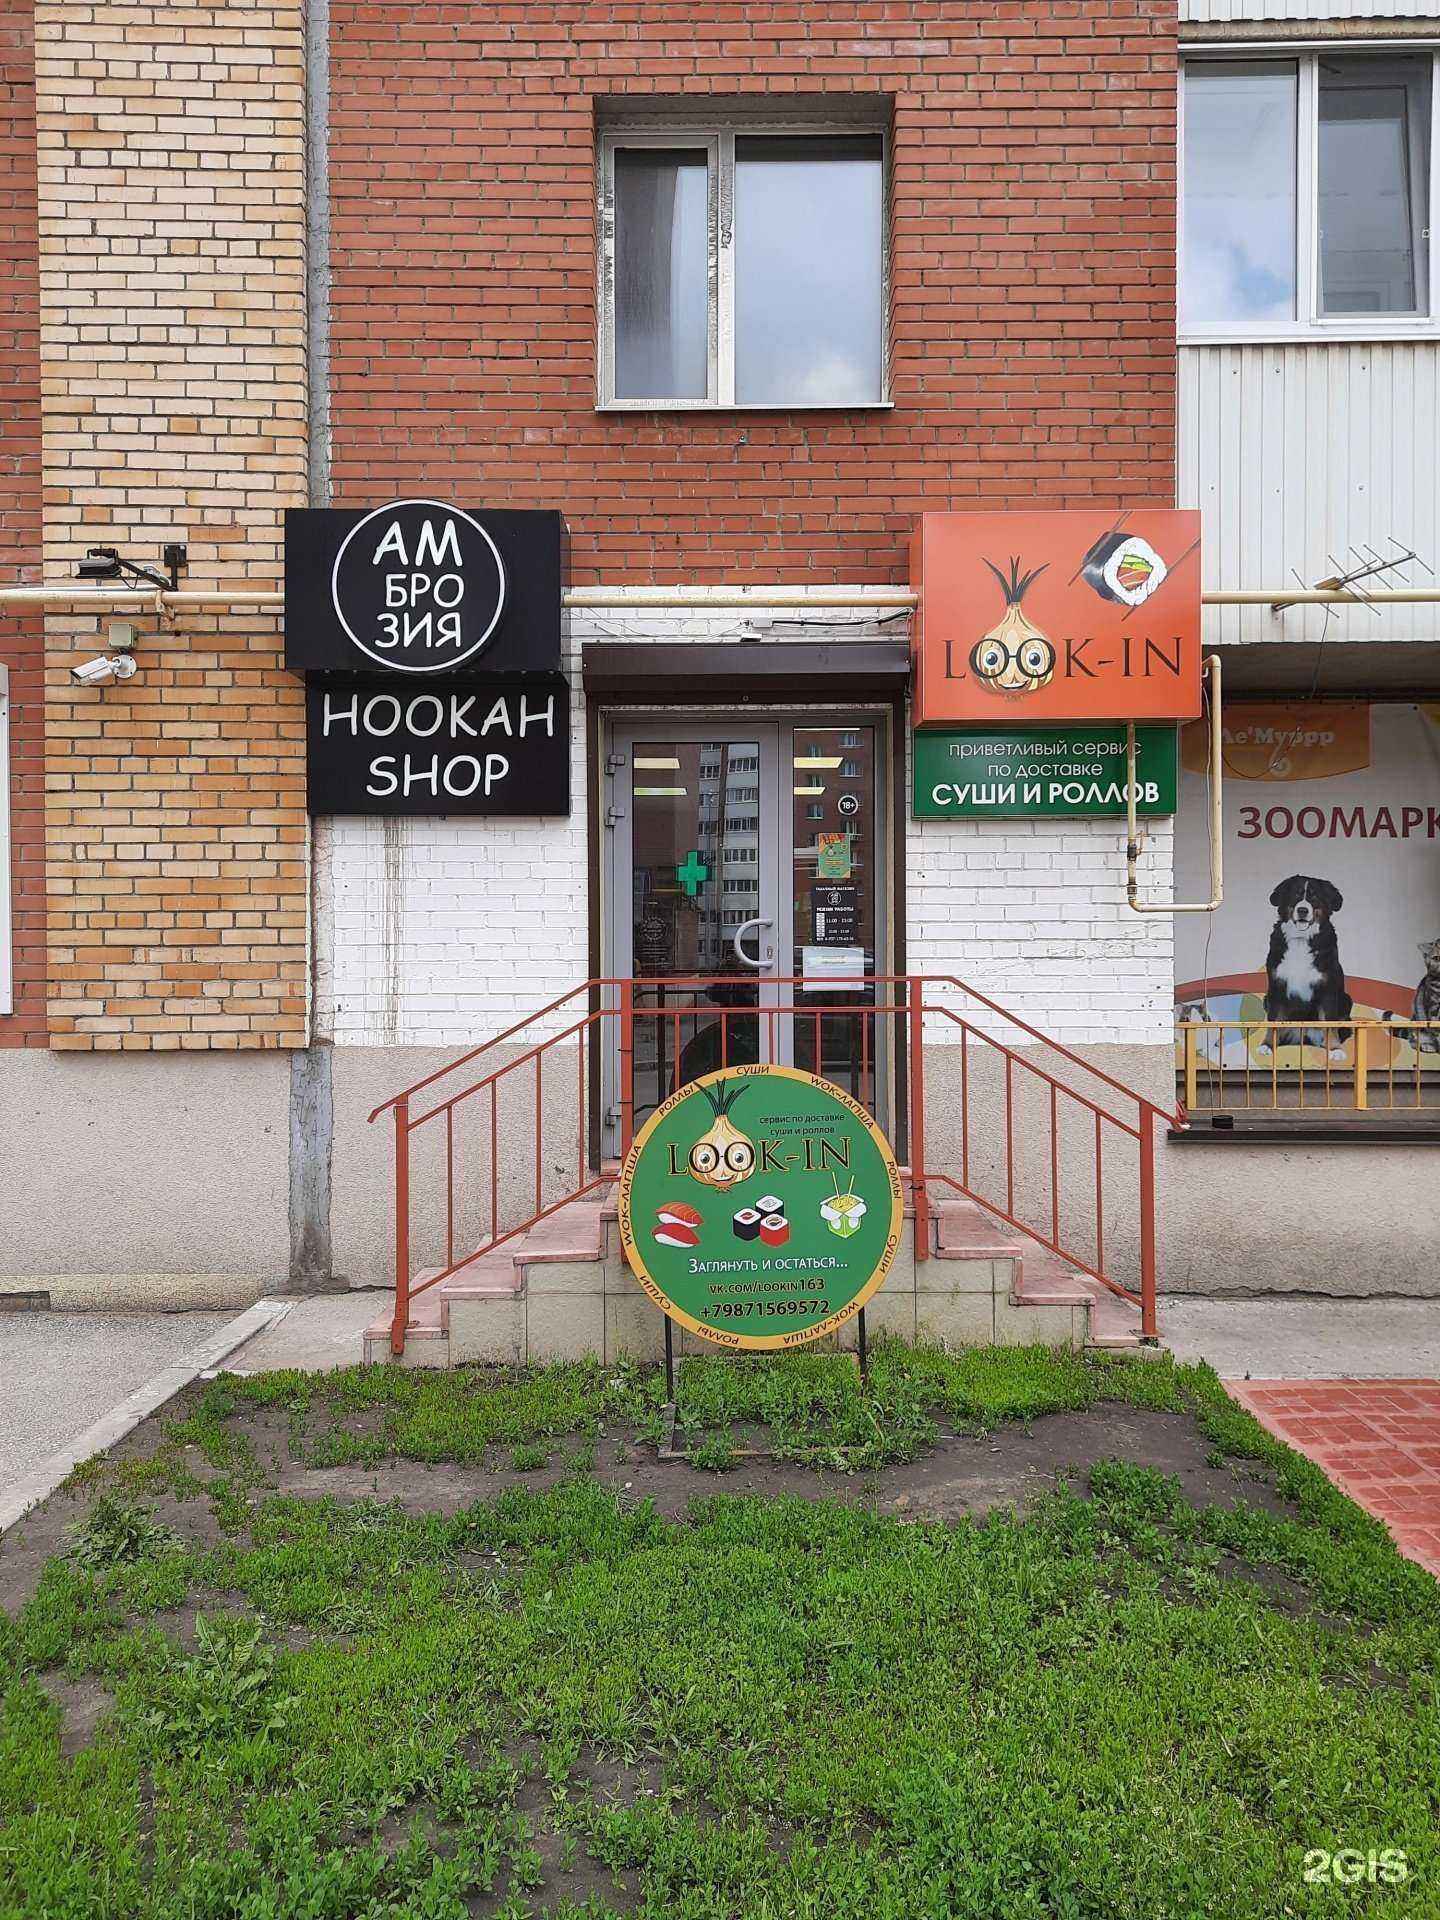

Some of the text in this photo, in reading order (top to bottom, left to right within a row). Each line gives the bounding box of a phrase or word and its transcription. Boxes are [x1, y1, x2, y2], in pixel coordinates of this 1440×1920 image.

[372, 519, 463, 566] АМ
[386, 573, 464, 608] БРО
[374, 612, 461, 648] ЗИЯ
[943, 636, 1184, 679] LOOK-IN
[322, 693, 554, 738] HOOKAH
[949, 740, 1143, 760] приветливый сервис
[366, 753, 510, 797] SHOP
[988, 764, 1103, 779] по доставке
[842, 801, 855, 809] 18+
[932, 782, 1160, 805] СУШИ И РОЛЛОВ
[736, 1065, 770, 1077] СУШИ
[658, 1084, 694, 1116] РОЛЛЫ
[810, 1075, 875, 1130] WOK-ЛАПША
[759, 1117, 791, 1125] сервис
[804, 1114, 845, 1124] доставке
[770, 1127, 793, 1137] суши
[803, 1127, 835, 1137] роллов
[666, 1137, 852, 1176] LOOK-IN
[887, 1161, 902, 1199] РОЛЛЫ
[879, 1234, 898, 1274] СУШИ
[639, 1275, 671, 1311] СУШИ
[701, 1300, 830, 1318] +79871569572
[696, 1326, 739, 1345] РОЛЛЫ
